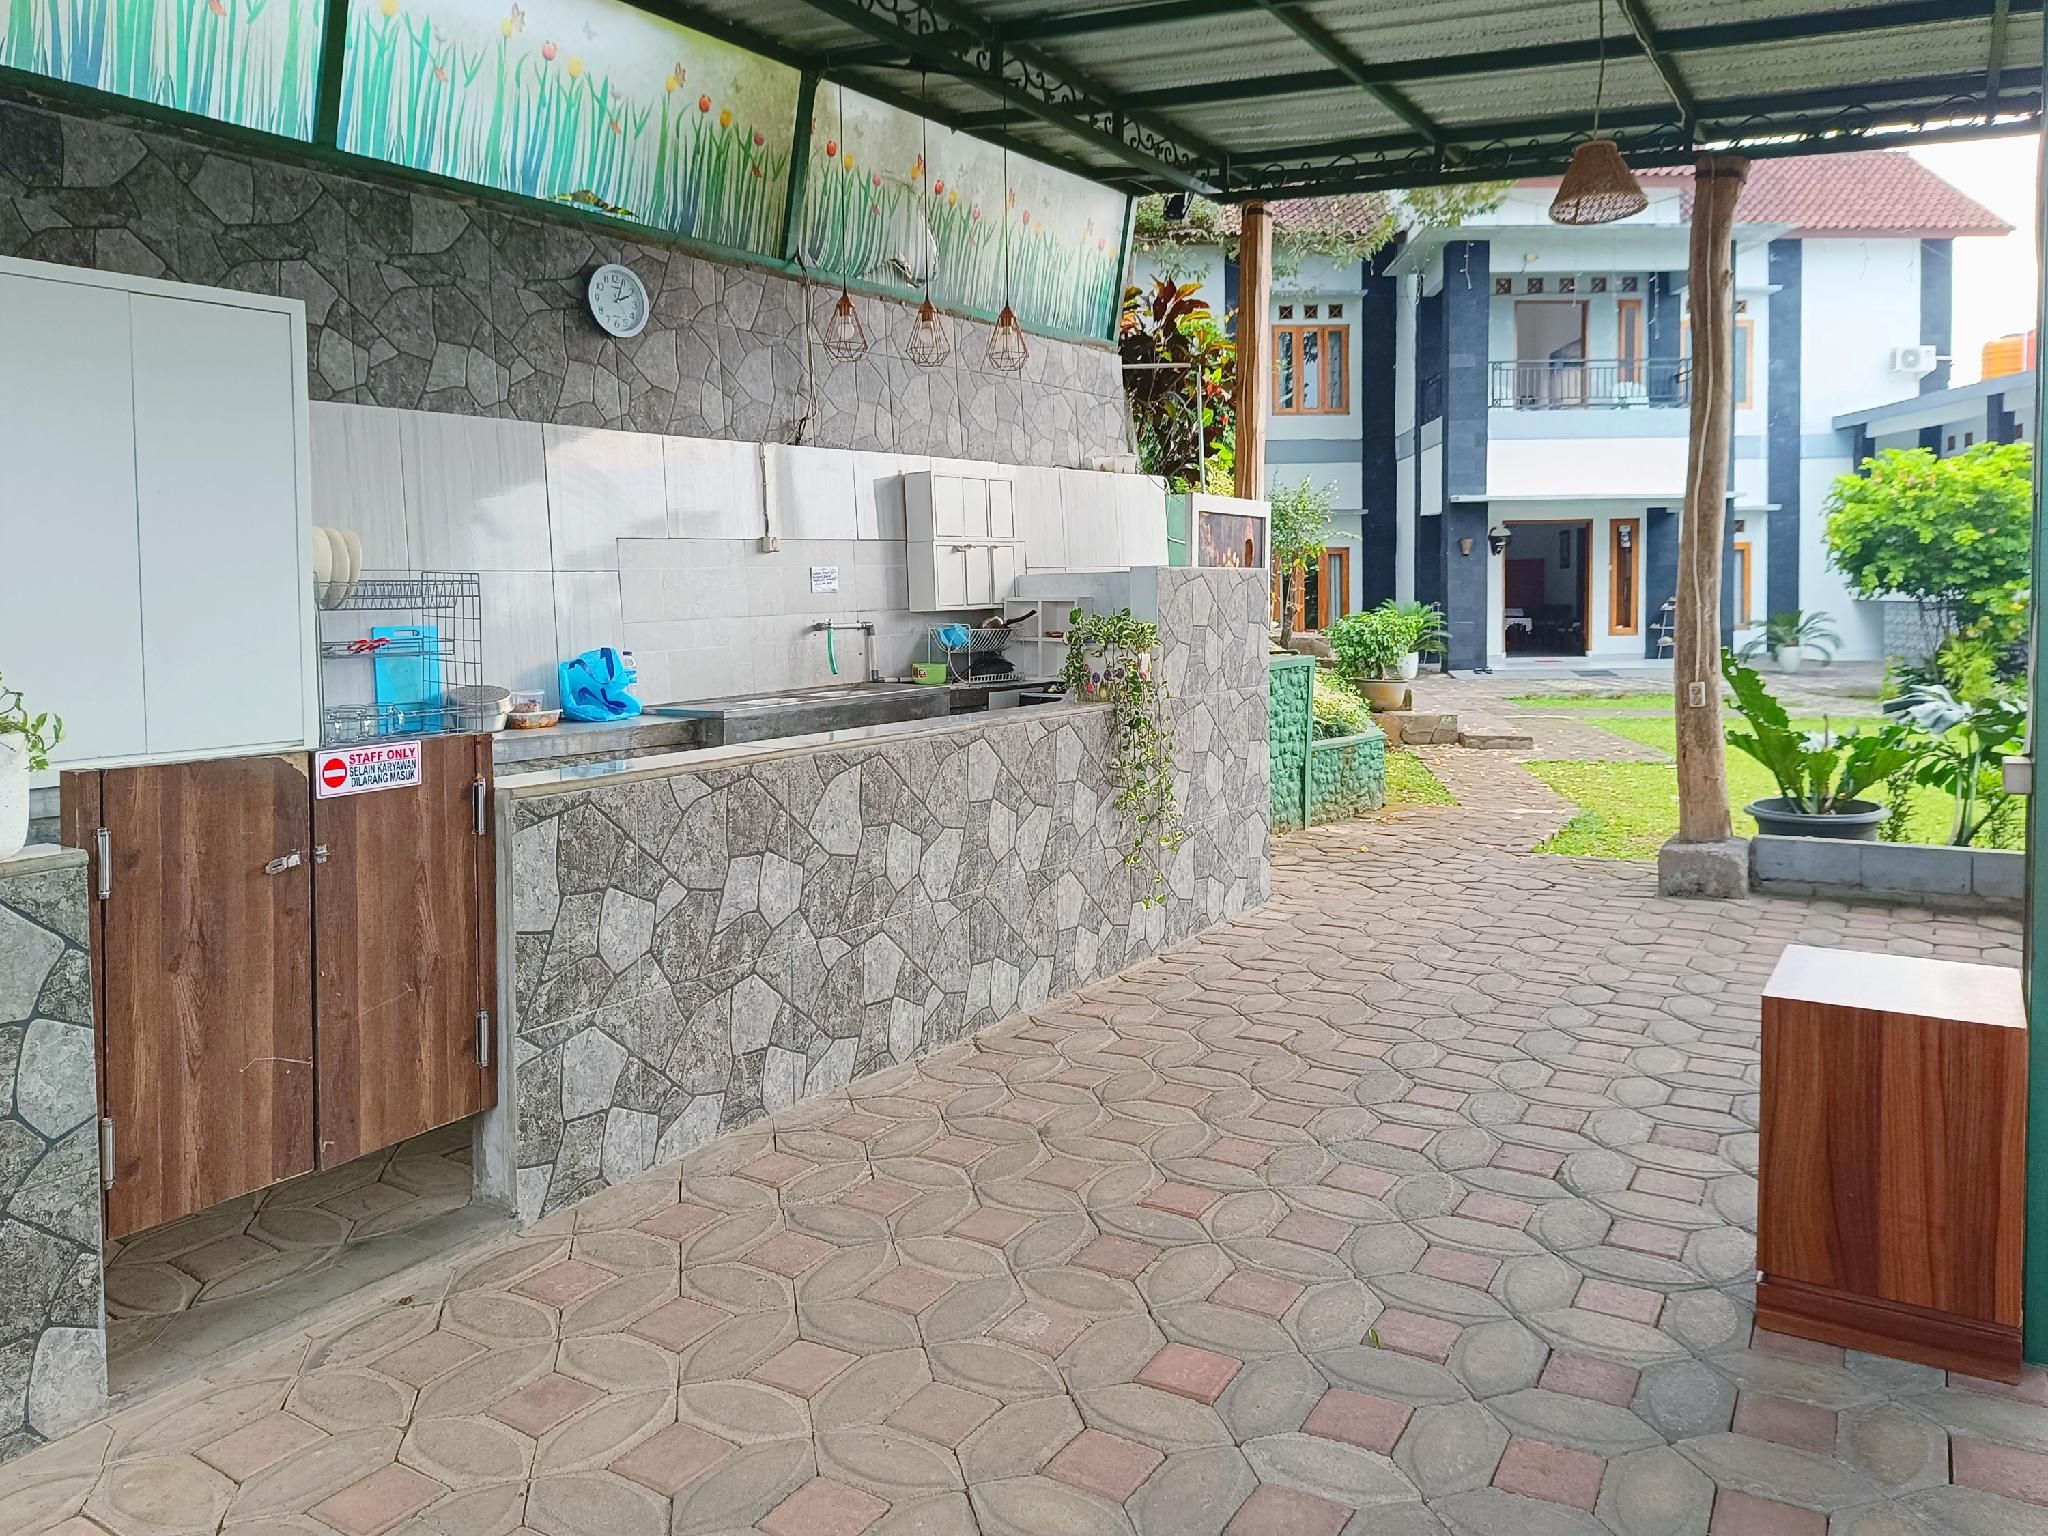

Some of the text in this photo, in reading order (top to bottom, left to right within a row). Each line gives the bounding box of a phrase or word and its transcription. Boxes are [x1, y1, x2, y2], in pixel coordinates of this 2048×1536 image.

[604, 275, 609, 283] 11
[612, 274, 619, 283] 12
[597, 282, 604, 291] 10
[594, 293, 600, 302] 9
[632, 301, 638, 310] 3
[598, 306, 604, 315] 8
[606, 315, 610, 324] 7
[629, 312, 635, 320] 4
[614, 320, 620, 328] 6
[622, 319, 629, 328] 5
[349, 747, 416, 764] STAFF ONLY
[349, 759, 417, 777] SELAIN KARYAWAN
[351, 770, 416, 787] DILARANG MASUK
